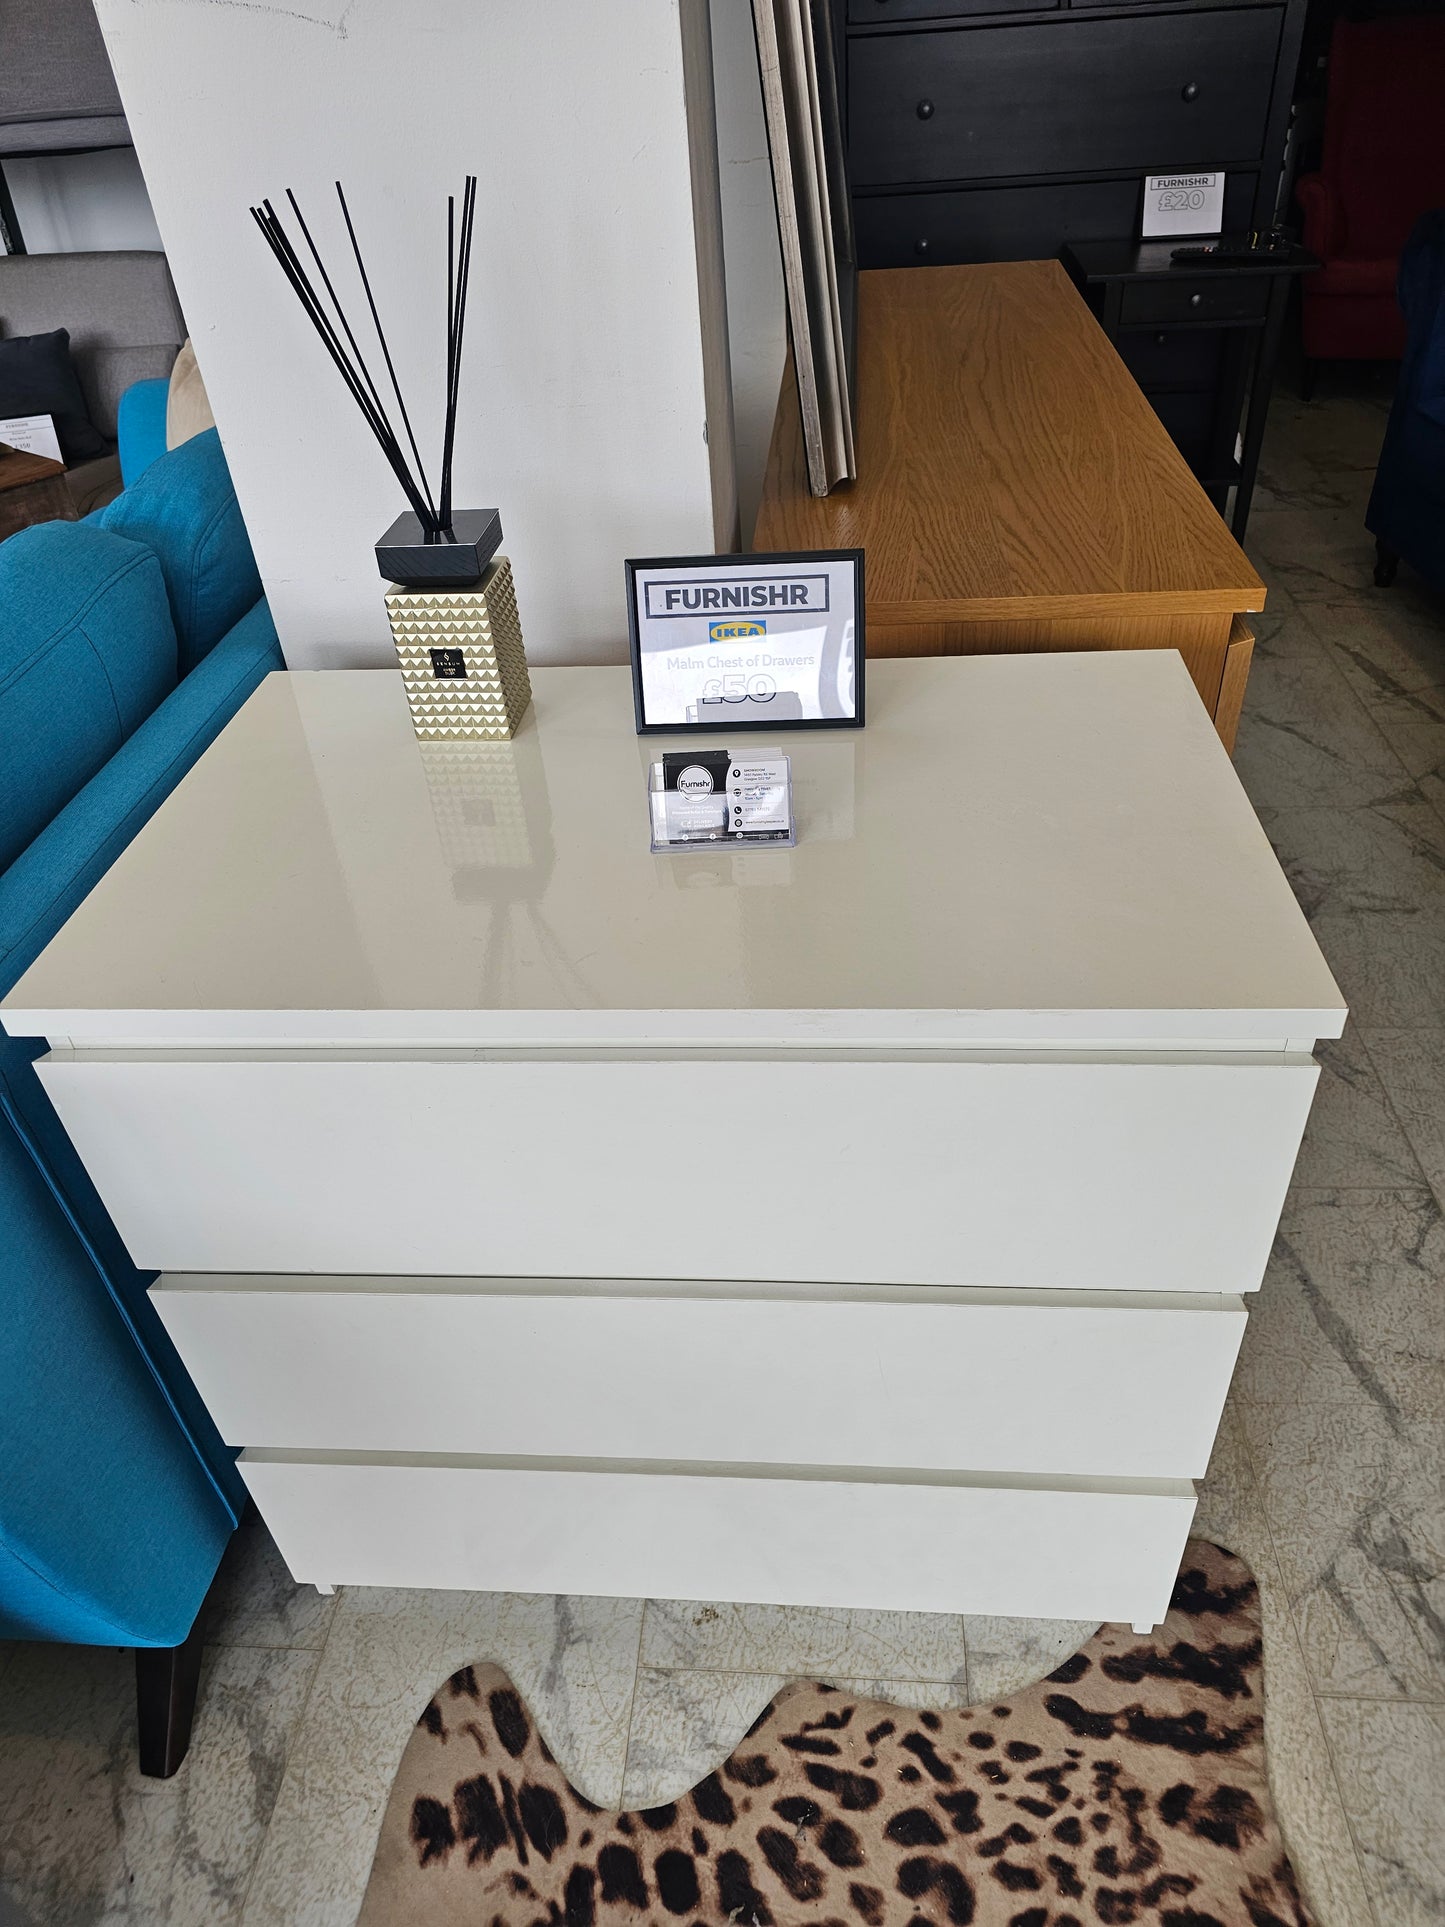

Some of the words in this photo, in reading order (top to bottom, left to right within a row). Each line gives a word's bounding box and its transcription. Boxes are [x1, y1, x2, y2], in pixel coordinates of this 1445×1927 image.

[1157, 177, 1209, 188] FURNISHR
[1158, 189, 1205, 212] £20
[665, 584, 809, 610] FURNISHR
[716, 627, 760, 638] IKEA
[667, 656, 704, 670] Malm
[707, 655, 743, 668] Chest
[745, 654, 760, 667] of
[762, 654, 815, 667] Drawers
[702, 673, 777, 704] £50
[680, 780, 711, 788] Furnishr
